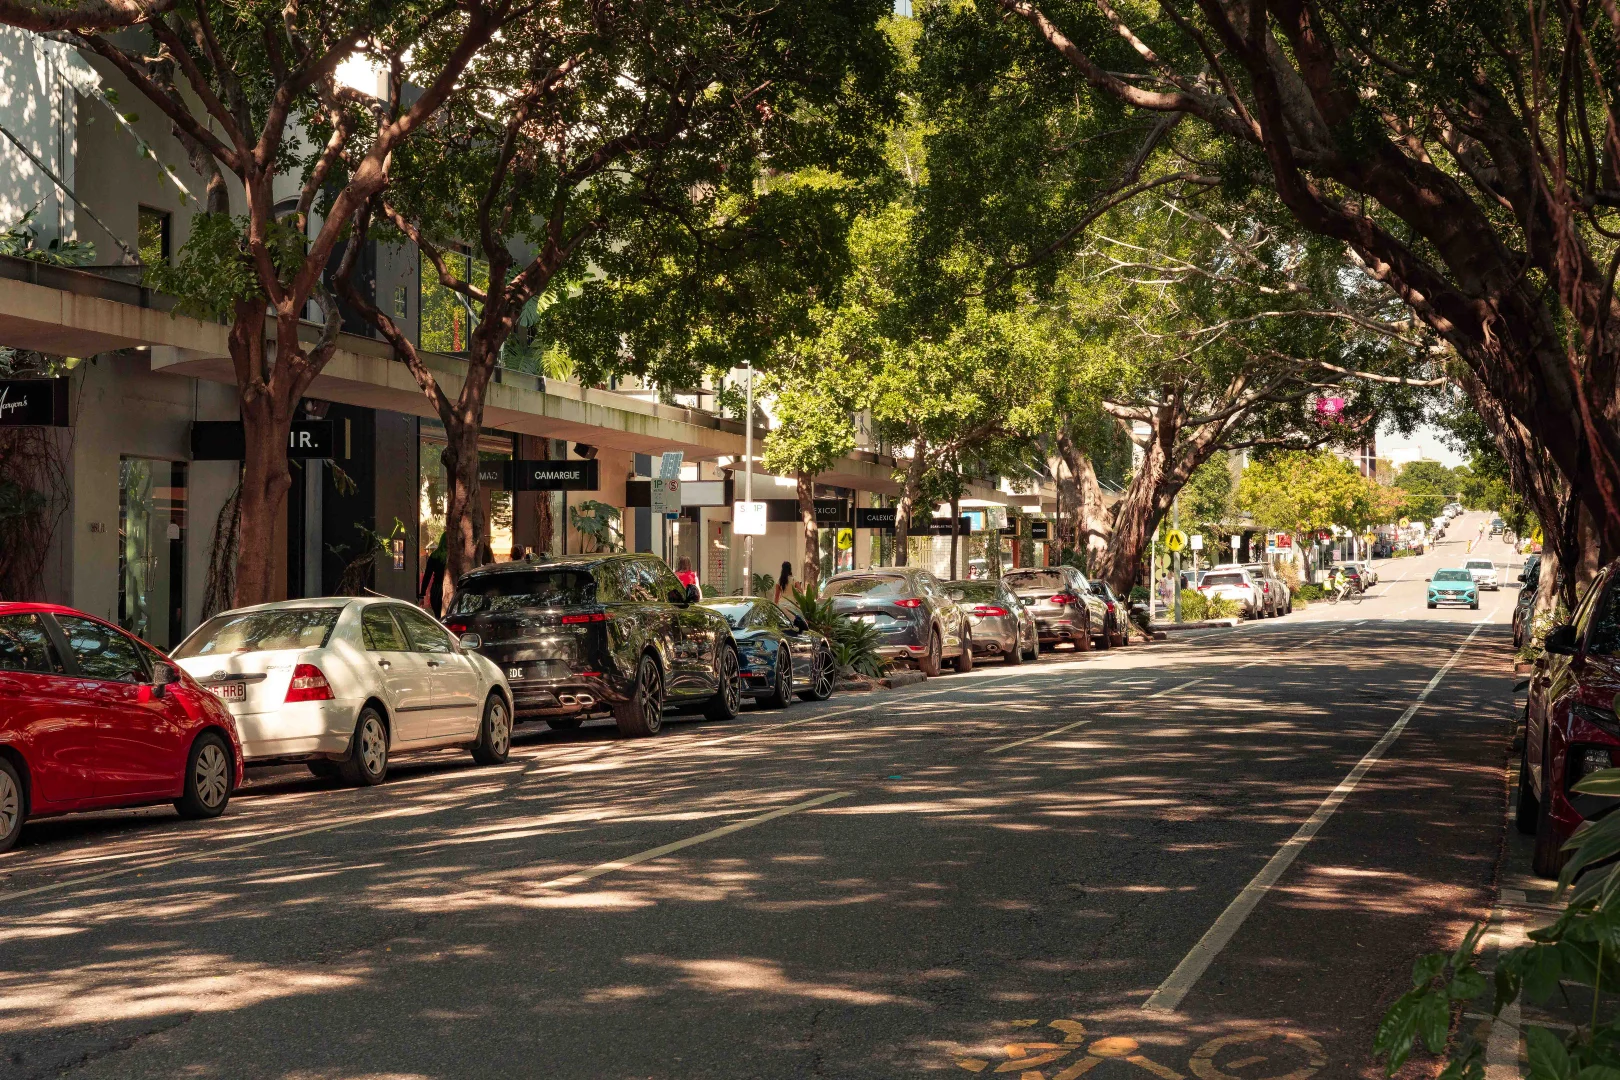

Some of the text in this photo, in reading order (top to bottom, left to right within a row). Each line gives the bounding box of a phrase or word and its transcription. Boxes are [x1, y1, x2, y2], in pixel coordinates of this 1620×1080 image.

[534, 471, 580, 480] CAMARGUE
[653, 479, 663, 489] 1P
[753, 504, 763, 512] 1P
